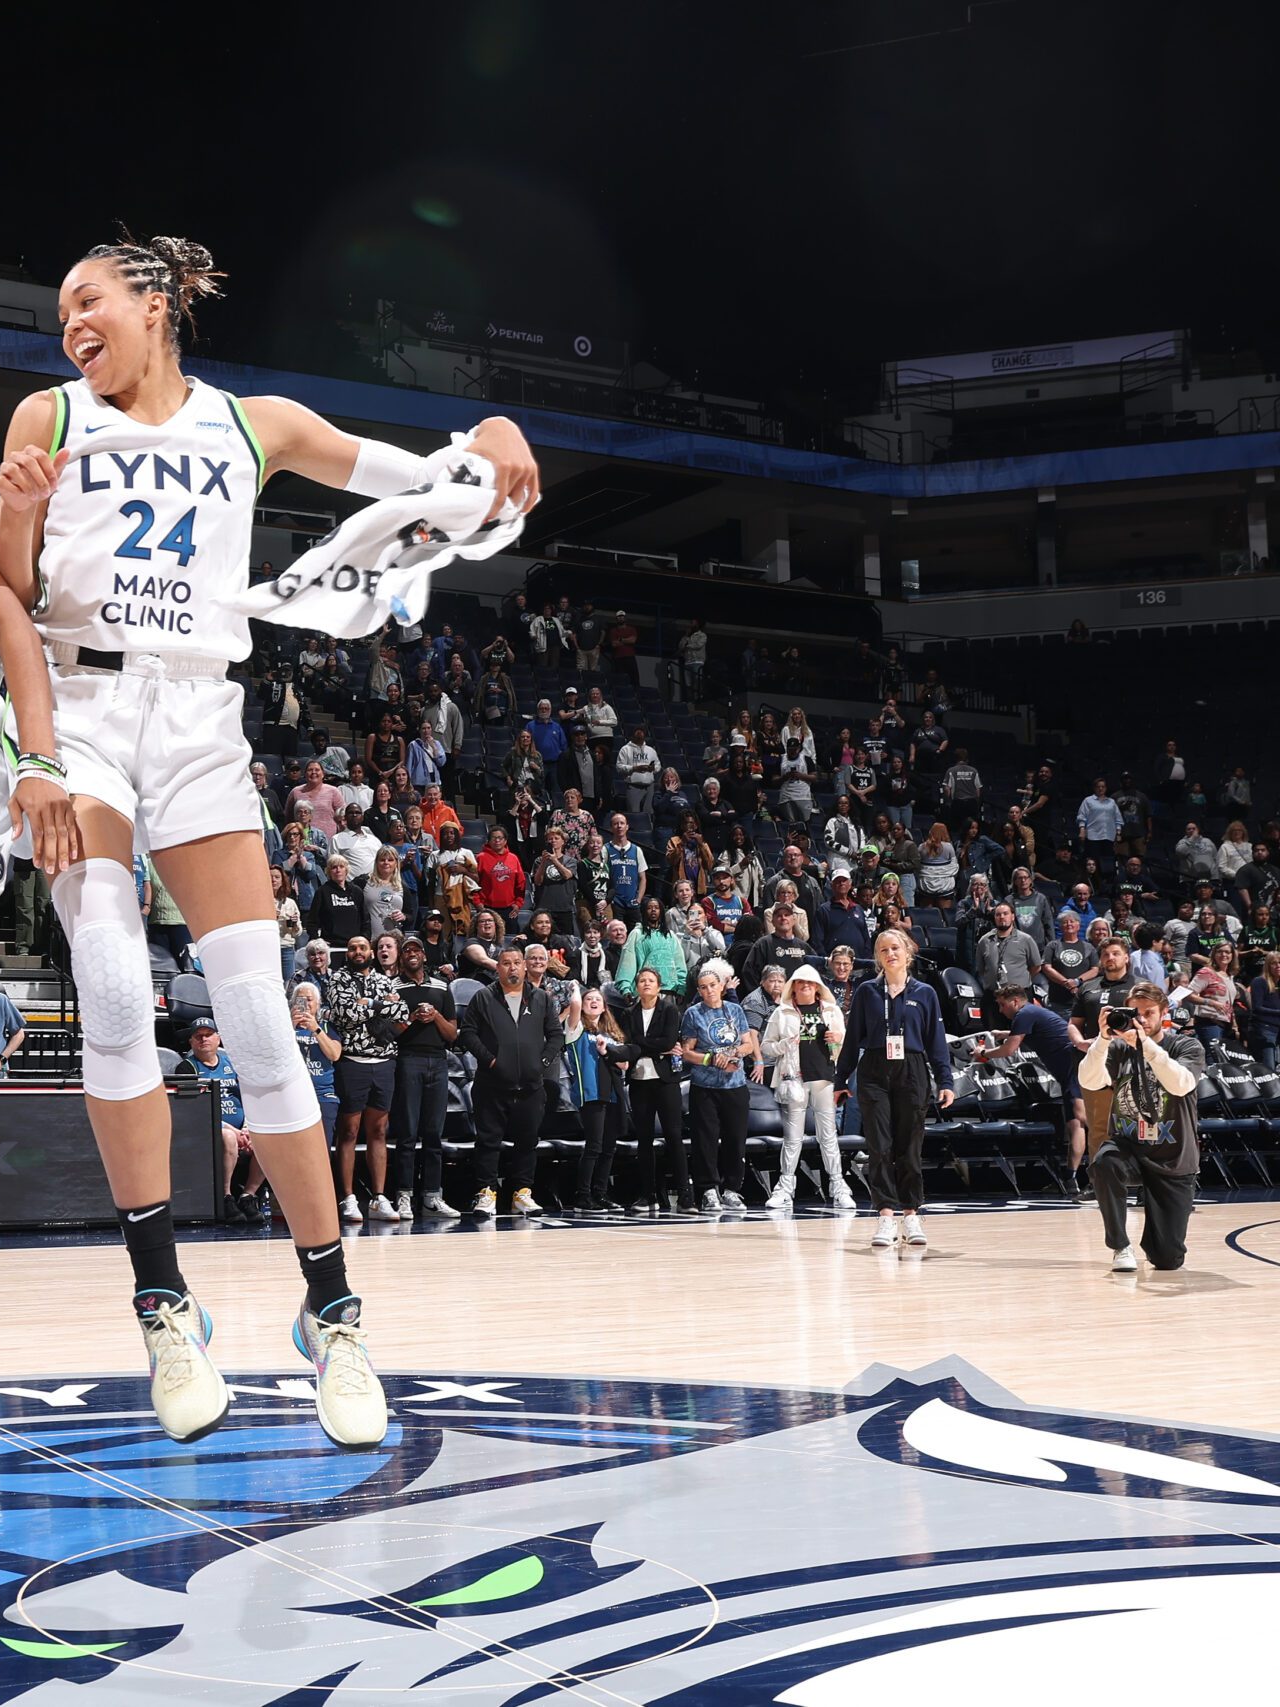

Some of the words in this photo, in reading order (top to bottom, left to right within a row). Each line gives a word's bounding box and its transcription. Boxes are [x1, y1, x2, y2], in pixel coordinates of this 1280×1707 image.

[498, 328, 544, 344] PENTAIR
[81, 453, 232, 502] LYNX
[113, 499, 198, 567] 24
[113, 573, 192, 604] MAYO
[1136, 590, 1167, 605] 136
[100, 601, 194, 635] CLINIC
[859, 777, 868, 787] 34
[594, 880, 608, 892] 24
[1248, 937, 1270, 945] LYNX
[800, 1023, 818, 1036] 24
[1227, 1051, 1256, 1062] WNBA
[981, 1075, 1013, 1087] WNBA
[1223, 1073, 1253, 1084] WNBA
[1254, 1072, 1280, 1083] WNBA
